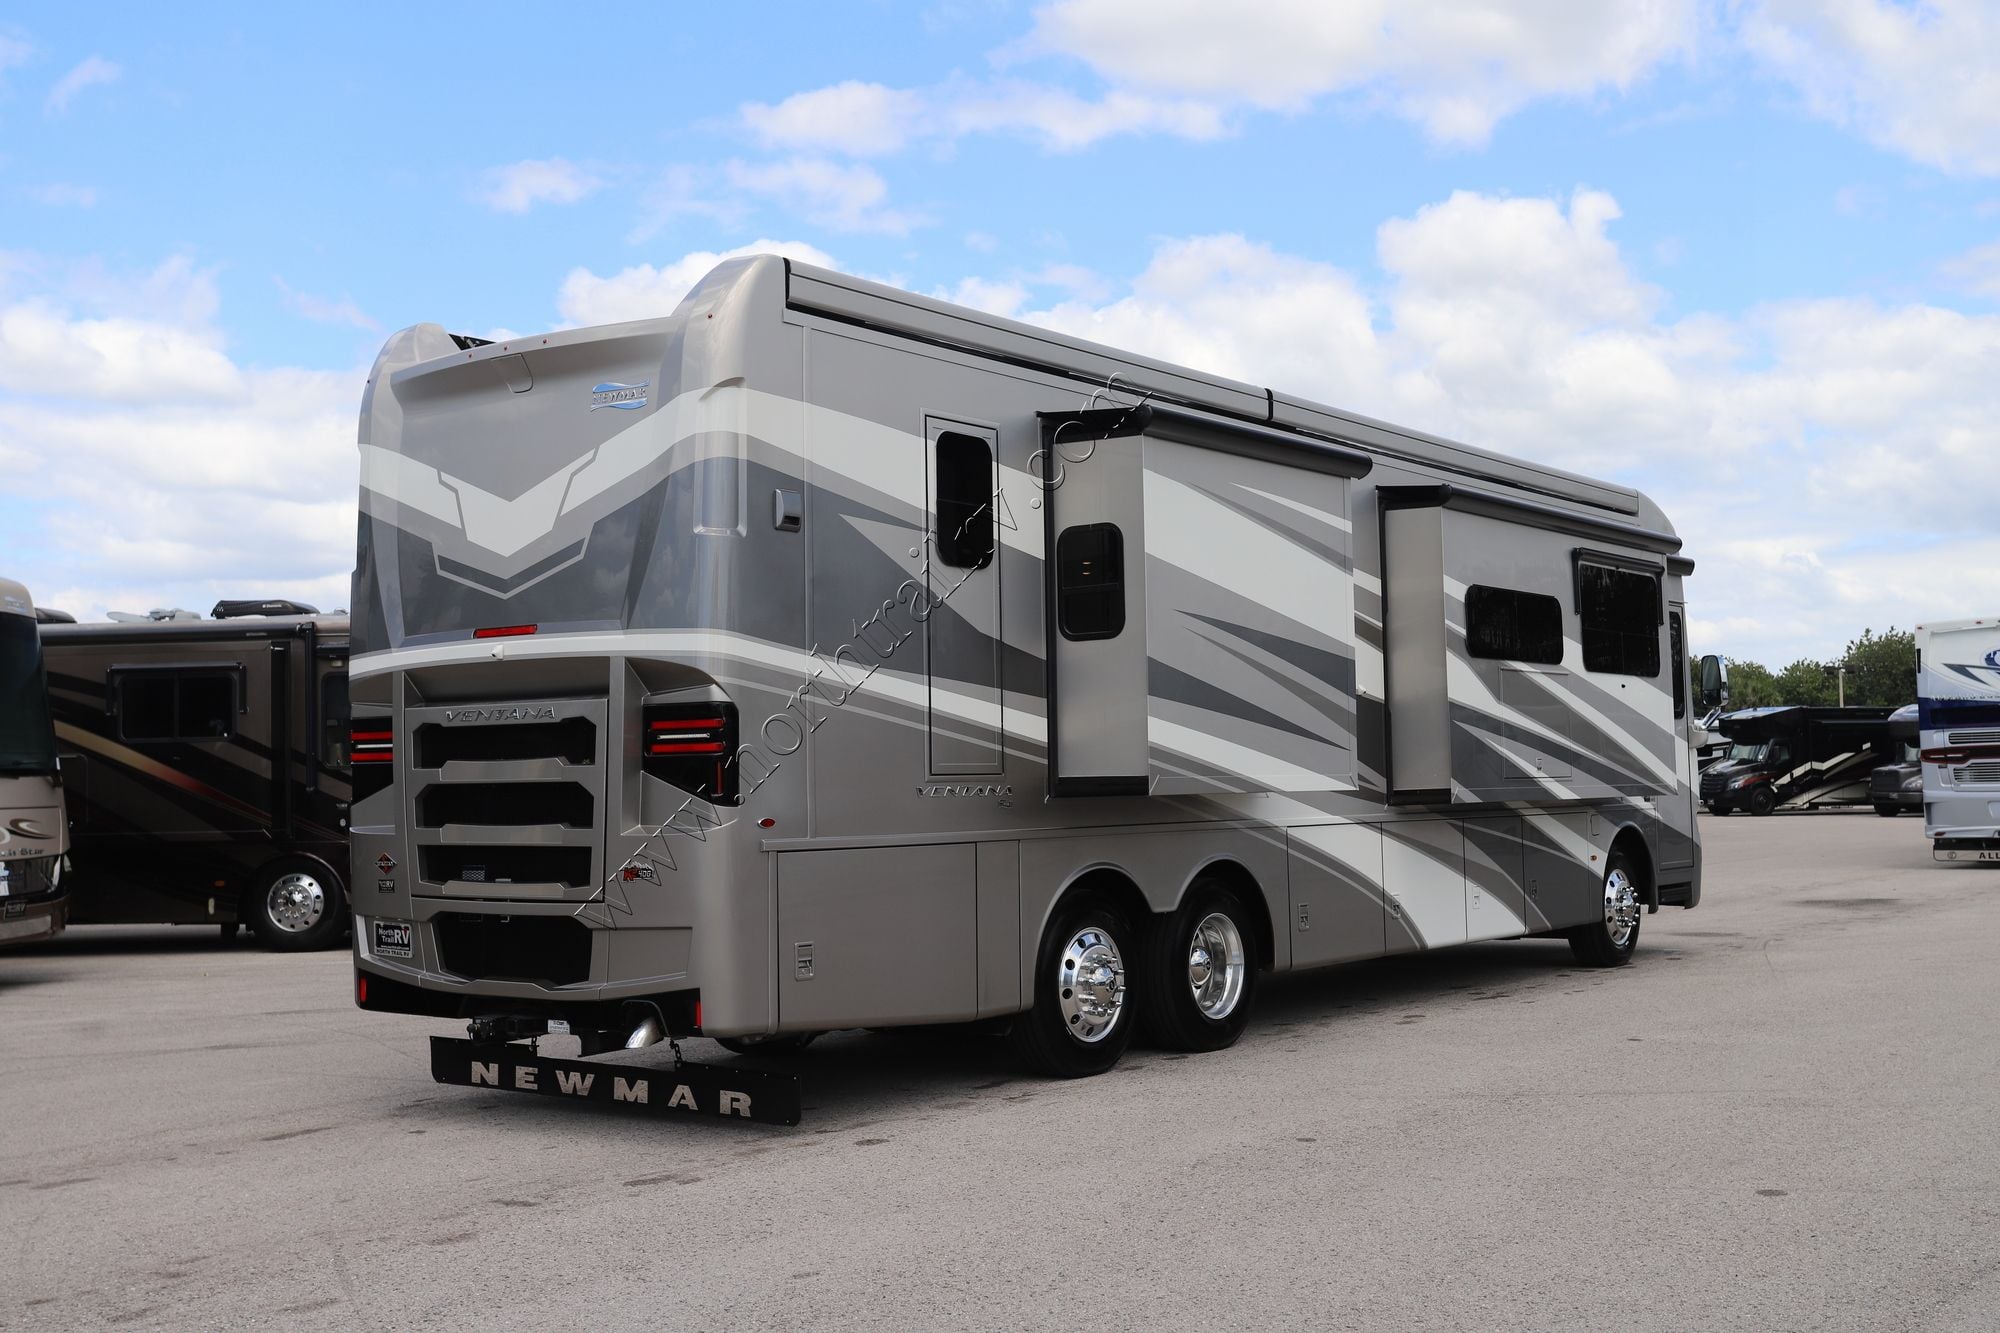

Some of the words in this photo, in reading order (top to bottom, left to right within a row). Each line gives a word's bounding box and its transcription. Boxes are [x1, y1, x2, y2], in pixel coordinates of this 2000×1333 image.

[593, 388, 646, 403] NEWMAR
[445, 706, 556, 722] VENTANA
[916, 785, 1013, 798] VENTANA
[394, 929, 409, 944] RV
[470, 1061, 752, 1118] NEWMAR
